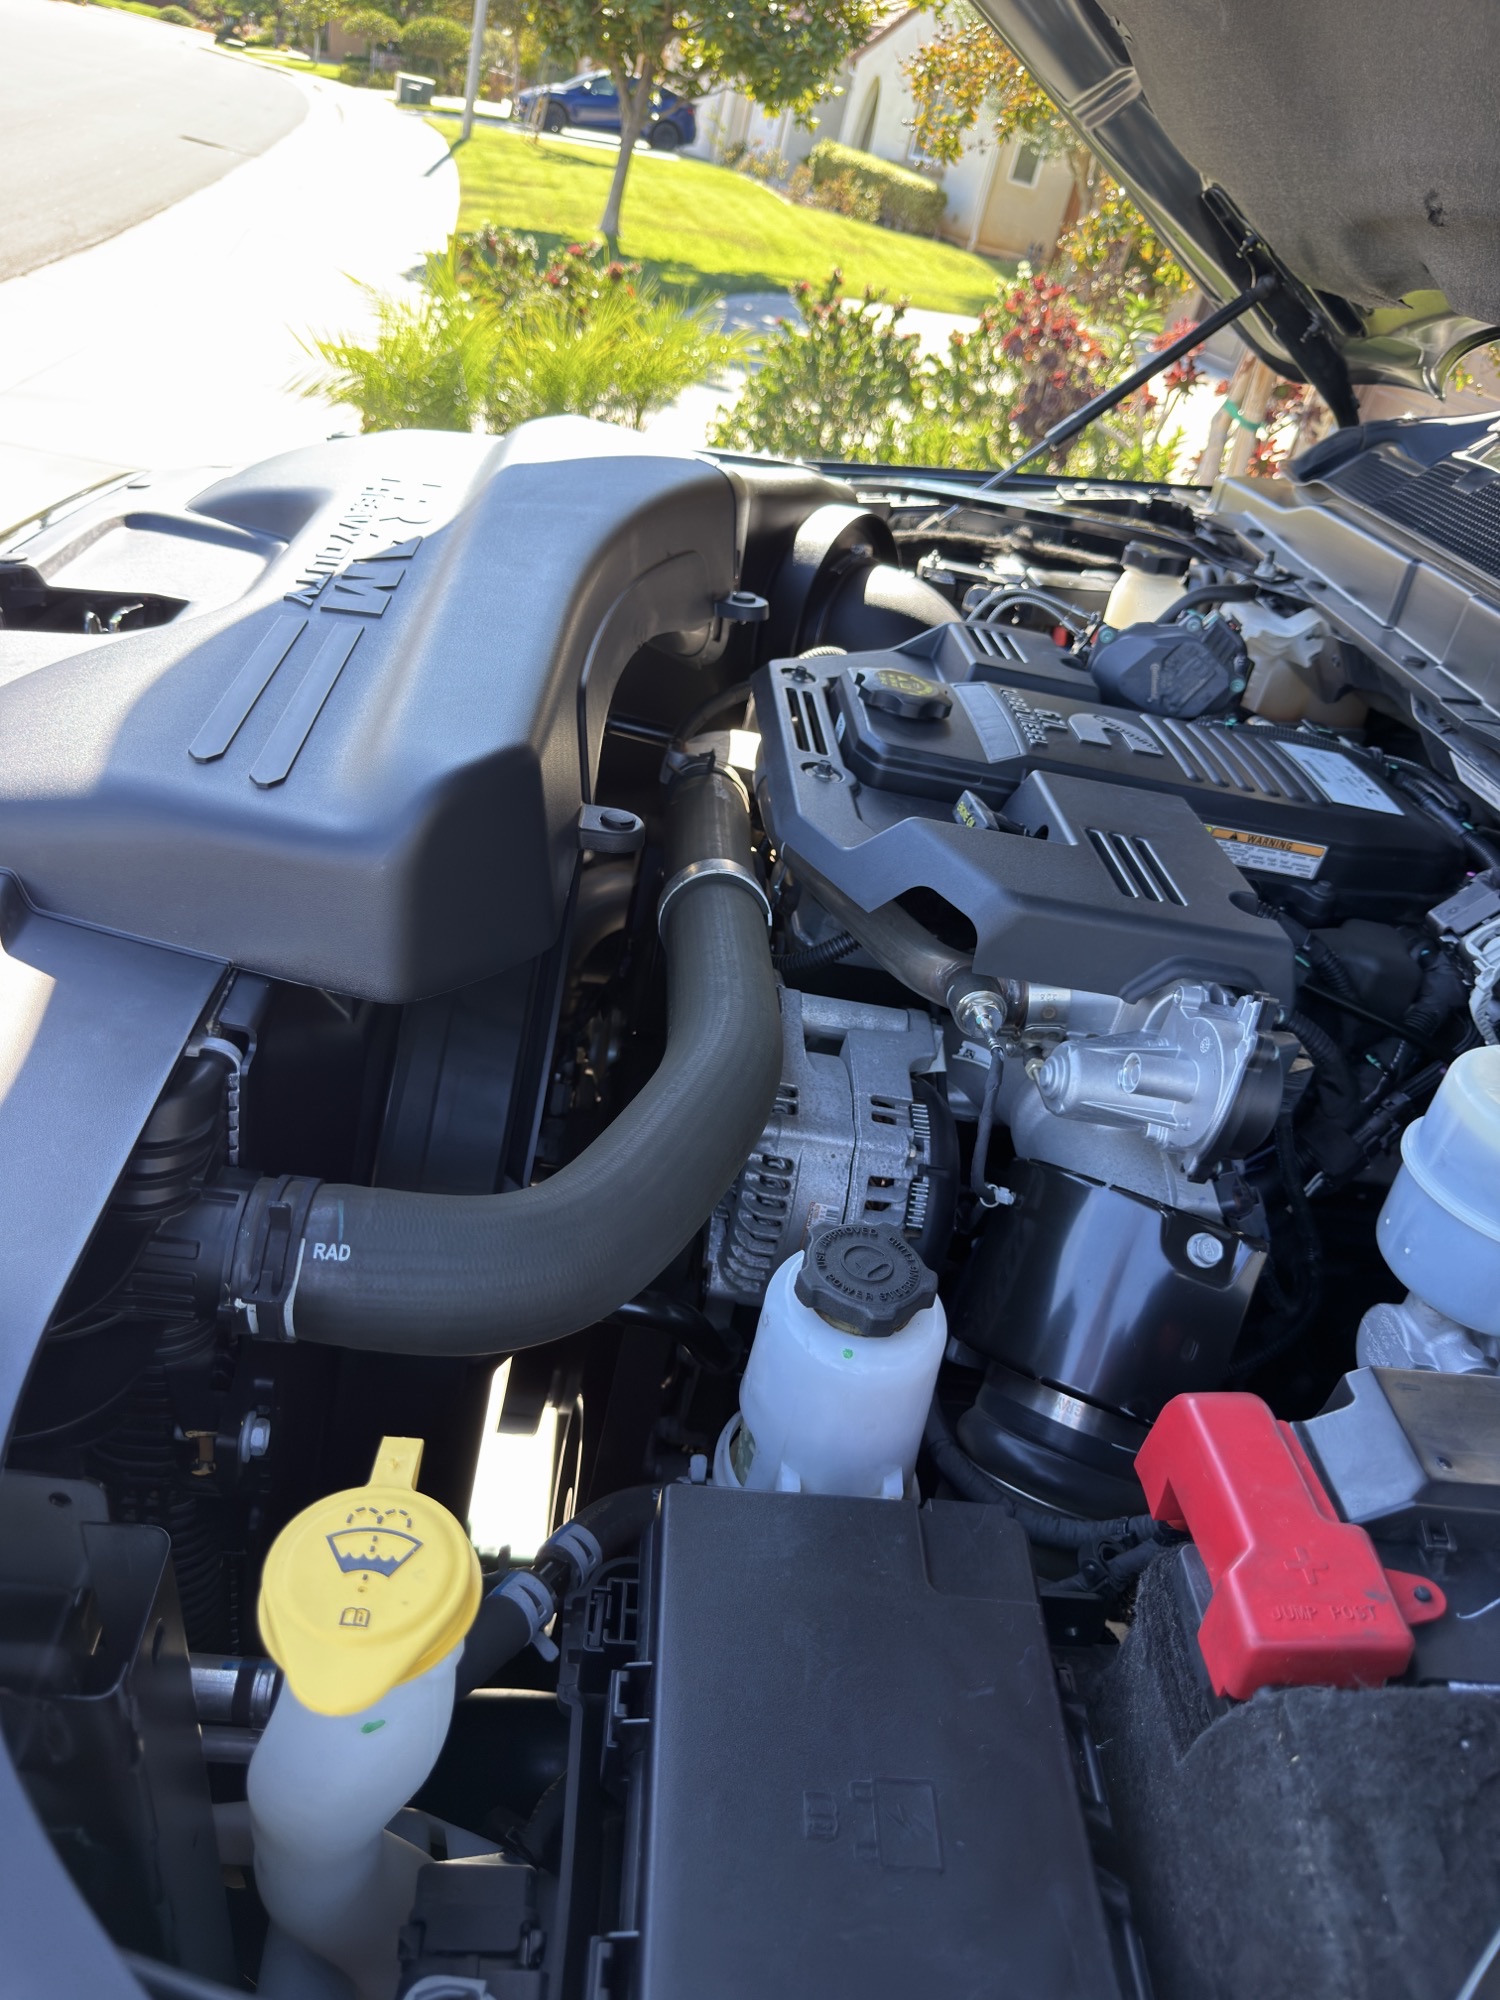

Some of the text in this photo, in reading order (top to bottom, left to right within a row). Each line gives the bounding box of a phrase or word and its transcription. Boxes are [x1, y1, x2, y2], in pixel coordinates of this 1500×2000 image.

[283, 546, 351, 611] DUTY
[1015, 713, 1048, 744] DIESEL
[1093, 714, 1159, 752] Cummins
[1247, 834, 1293, 850] WARNING
[313, 1242, 351, 1261] RAD
[816, 1227, 878, 1269] USE APPROVED
[826, 1237, 919, 1302] POWER STEERING FLUID
[1272, 1605, 1376, 1621] JUMP POST
